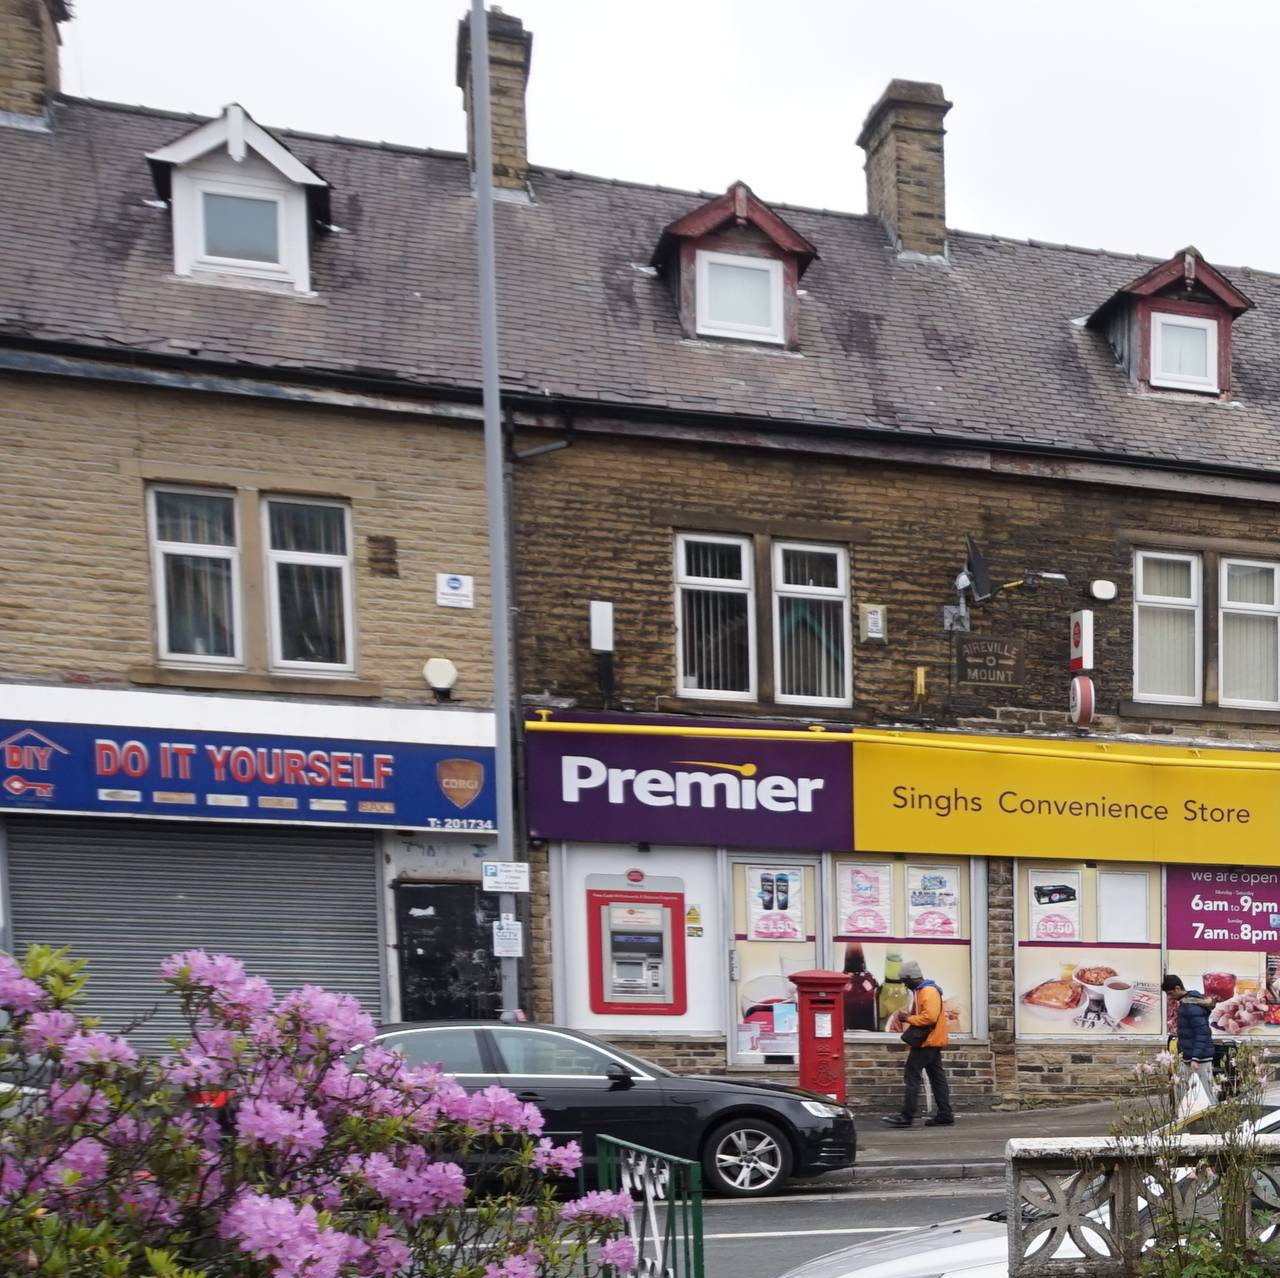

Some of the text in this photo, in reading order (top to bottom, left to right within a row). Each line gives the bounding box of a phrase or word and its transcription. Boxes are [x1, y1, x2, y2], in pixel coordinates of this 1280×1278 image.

[962, 641, 1019, 659] AIREVILLE
[967, 668, 1013, 682] MOUNT
[5, 745, 53, 770] DIY
[95, 738, 394, 789] DO IT YOURSELF
[441, 779, 479, 790] CORGI
[561, 755, 824, 813] Premier
[892, 786, 1250, 824] Singhs Convenience Store
[427, 817, 493, 830] T: 201734
[1191, 871, 1278, 886] we are open
[1191, 894, 1228, 911] 6am
[1240, 895, 1278, 916] 9pm
[1192, 922, 1228, 939] 7am
[1240, 924, 1278, 944] 8pm
